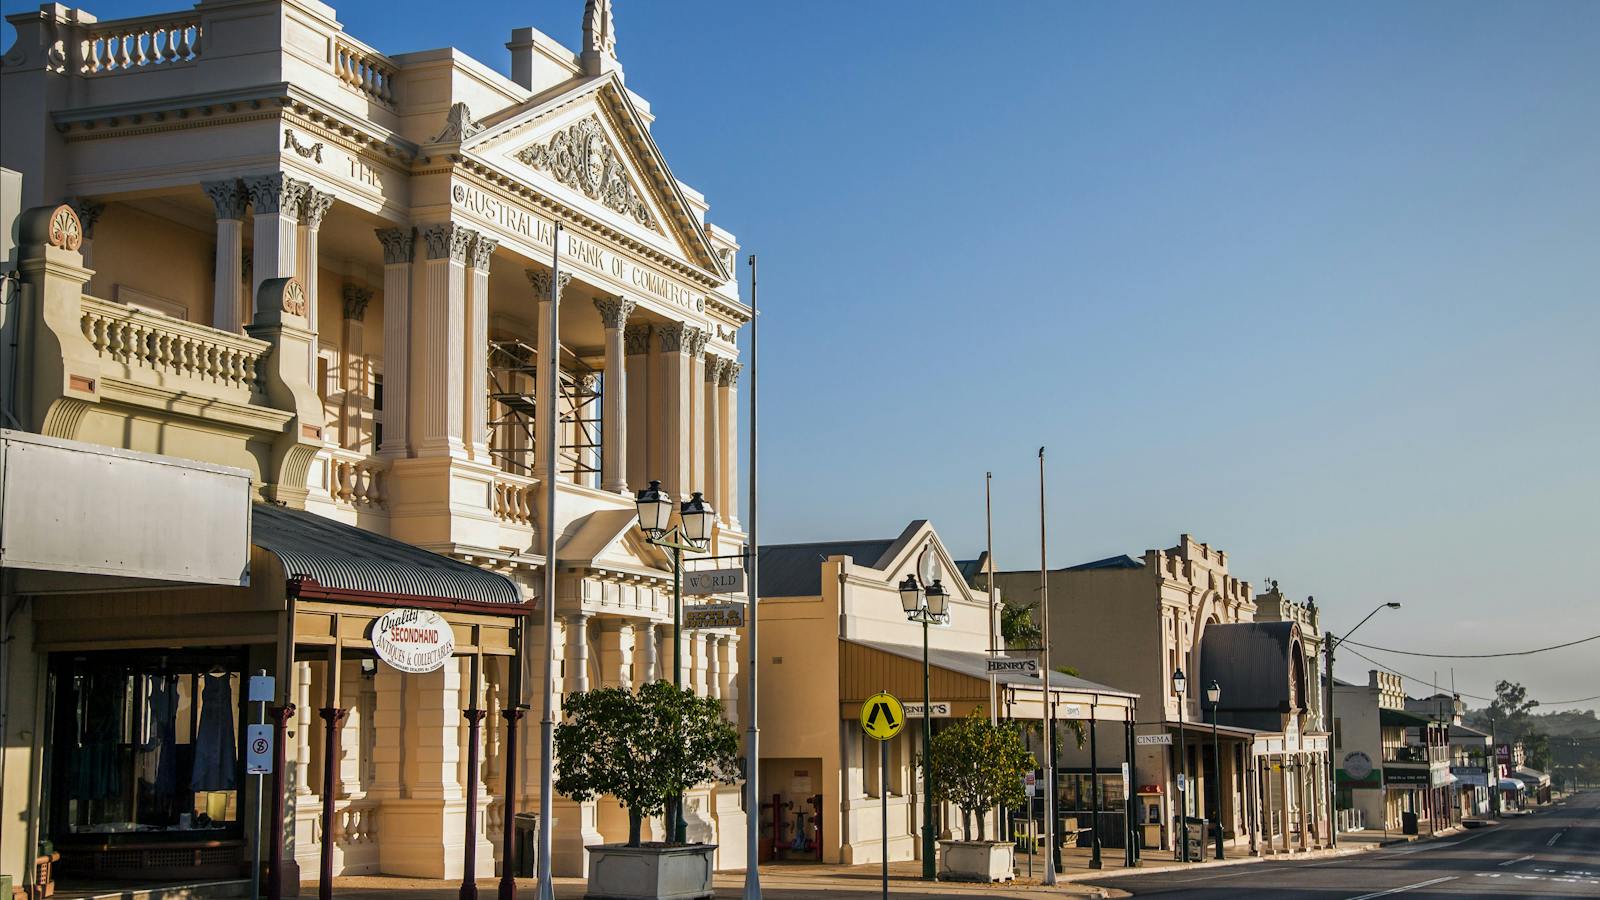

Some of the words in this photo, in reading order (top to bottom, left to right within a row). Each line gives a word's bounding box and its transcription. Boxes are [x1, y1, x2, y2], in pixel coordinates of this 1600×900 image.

[347, 157, 384, 190] THE
[567, 235, 604, 271] BANK
[611, 257, 628, 280] OF
[632, 267, 695, 311] COMMERCE
[380, 609, 419, 634] Quality
[391, 627, 439, 644] SECONDHAND
[376, 635, 406, 663] ANTIQUES
[407, 653, 412, 666] &
[414, 639, 454, 667] COLLECTABLES
[988, 660, 1036, 671] HENRY'S
[904, 704, 947, 714] ENY'S
[1137, 736, 1170, 744] CINEMA
